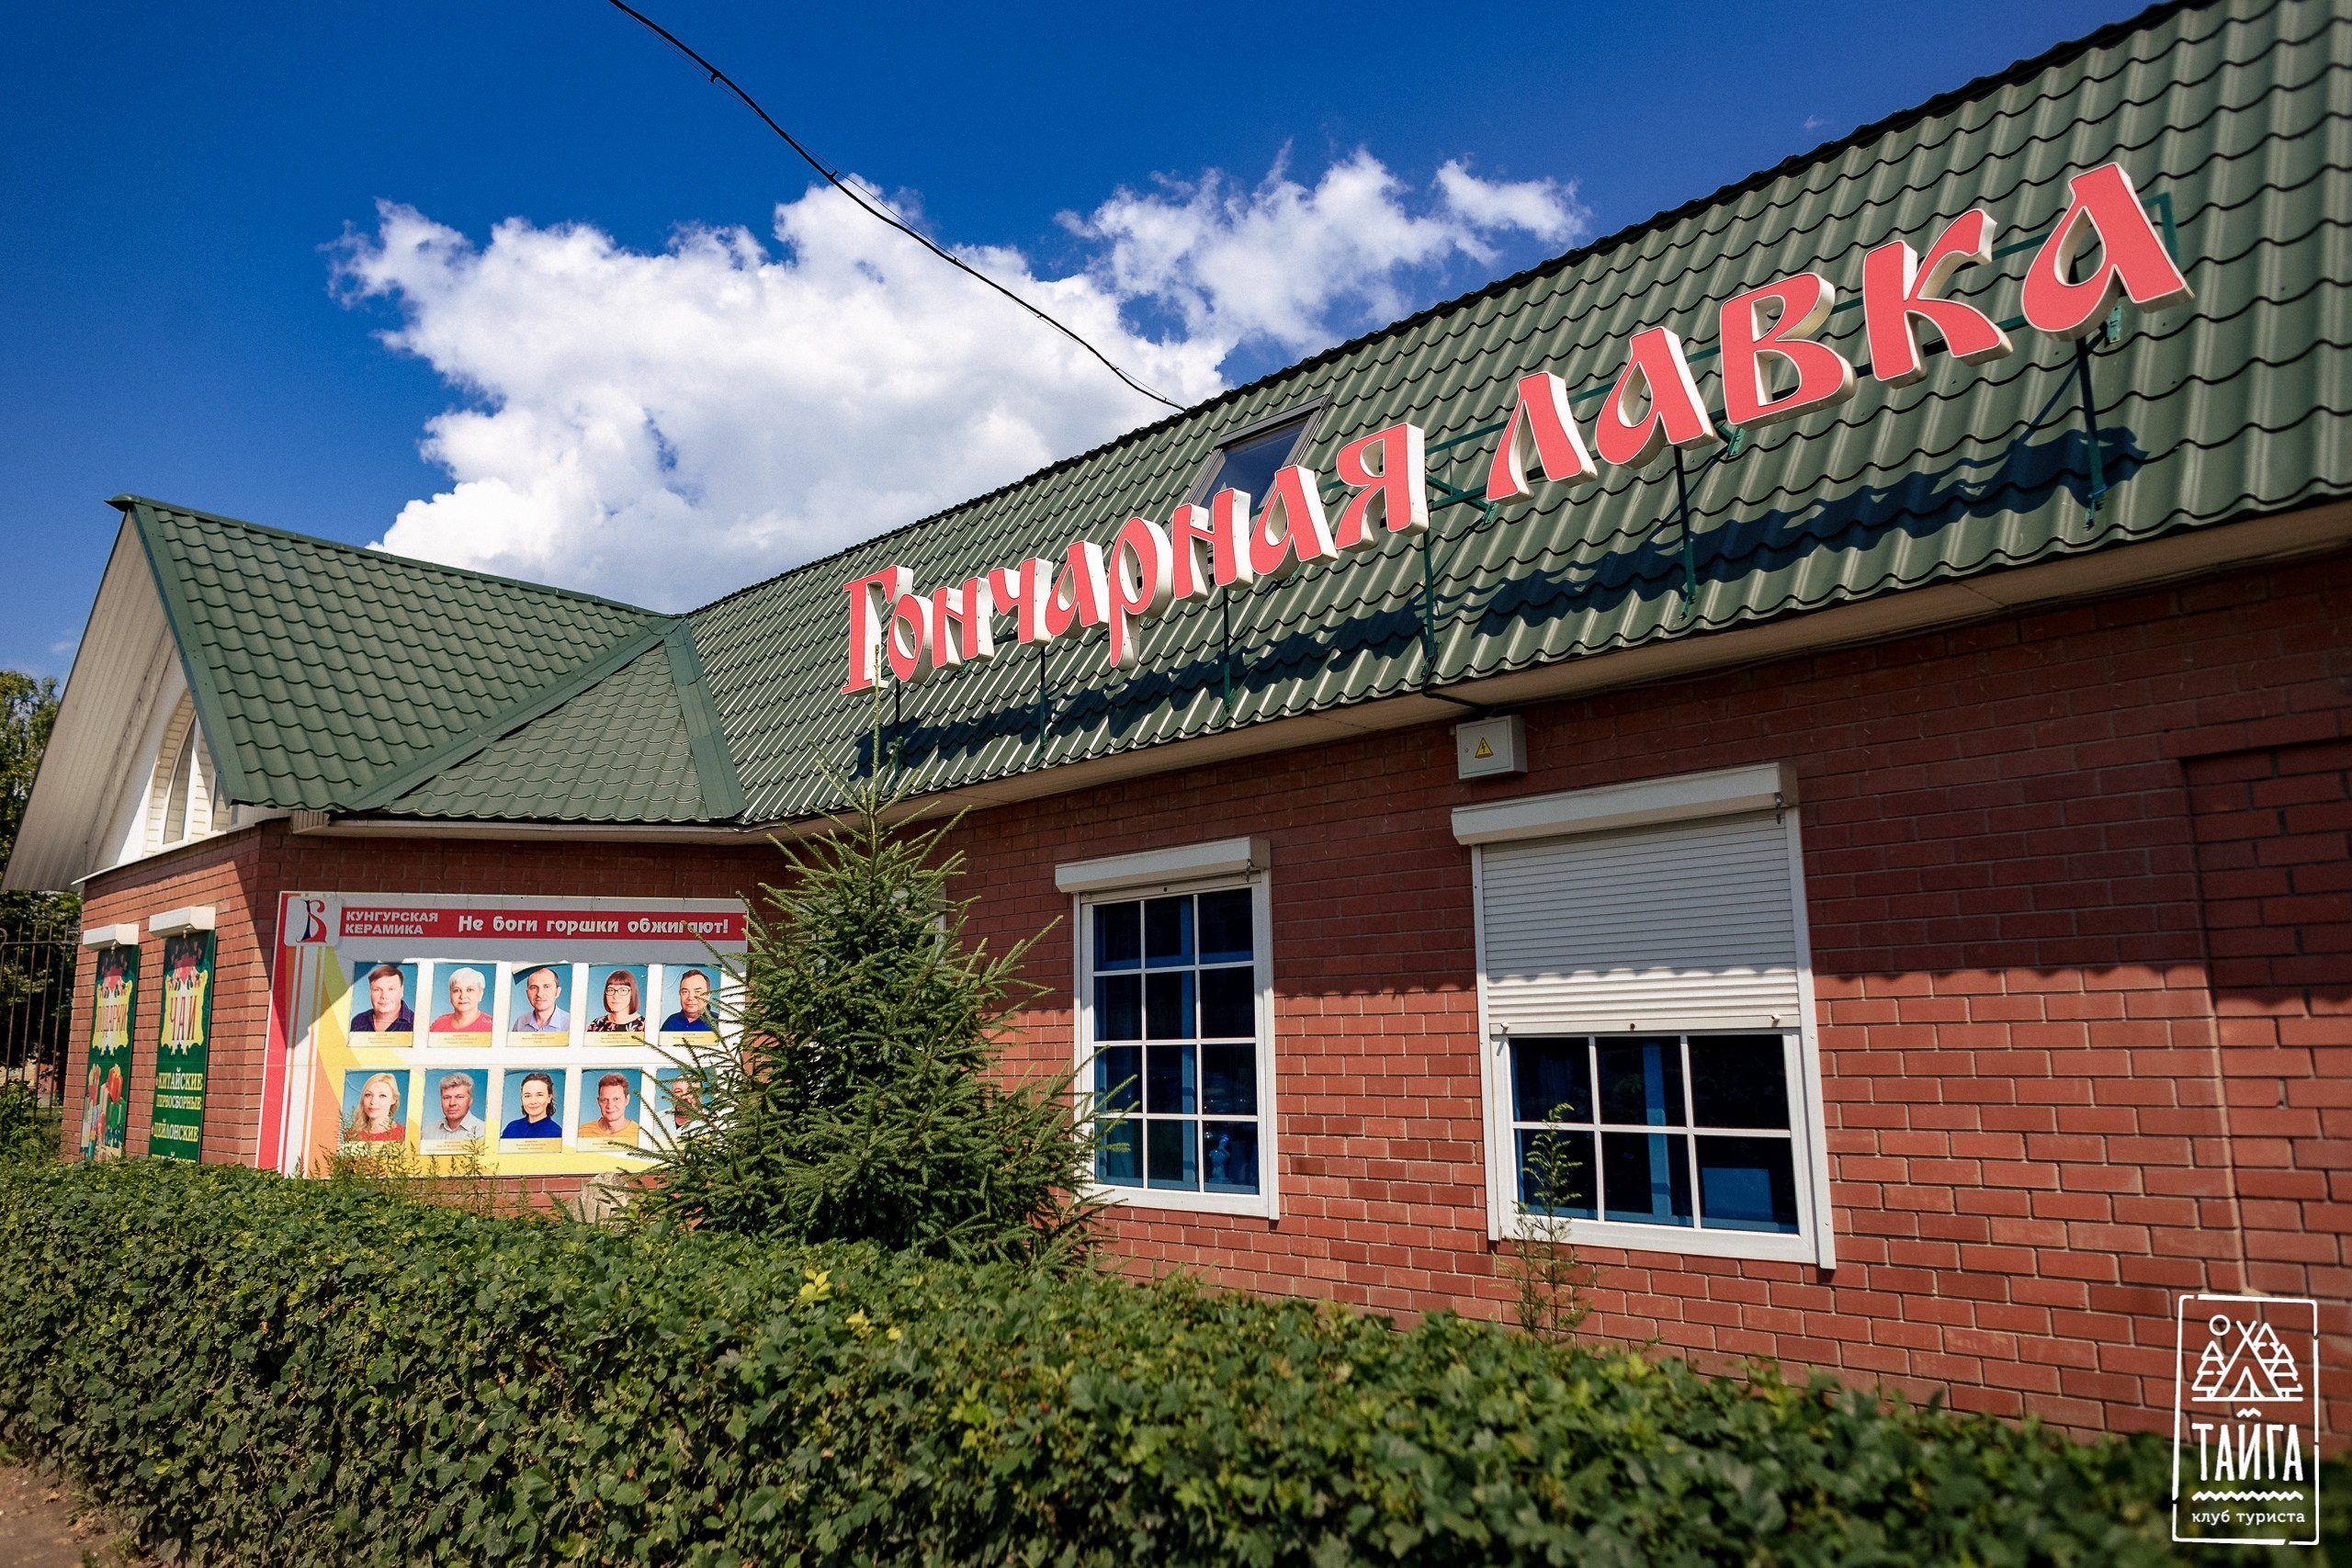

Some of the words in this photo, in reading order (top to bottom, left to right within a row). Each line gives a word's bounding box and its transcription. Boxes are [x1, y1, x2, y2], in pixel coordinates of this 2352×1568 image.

[345, 910, 439, 922] КУНГУРСКАЯ
[458, 915, 484, 932] Не
[492, 916, 538, 932] боги
[547, 919, 619, 935] горшки
[345, 923, 424, 934] КЕРАМИКА
[157, 1066, 203, 1090] КИТАЙСКИЕ
[156, 1094, 202, 1110] ПЕРВОСБОРНЫЕ
[153, 1118, 199, 1142] ЦЕЙЛОНСКИЕ
